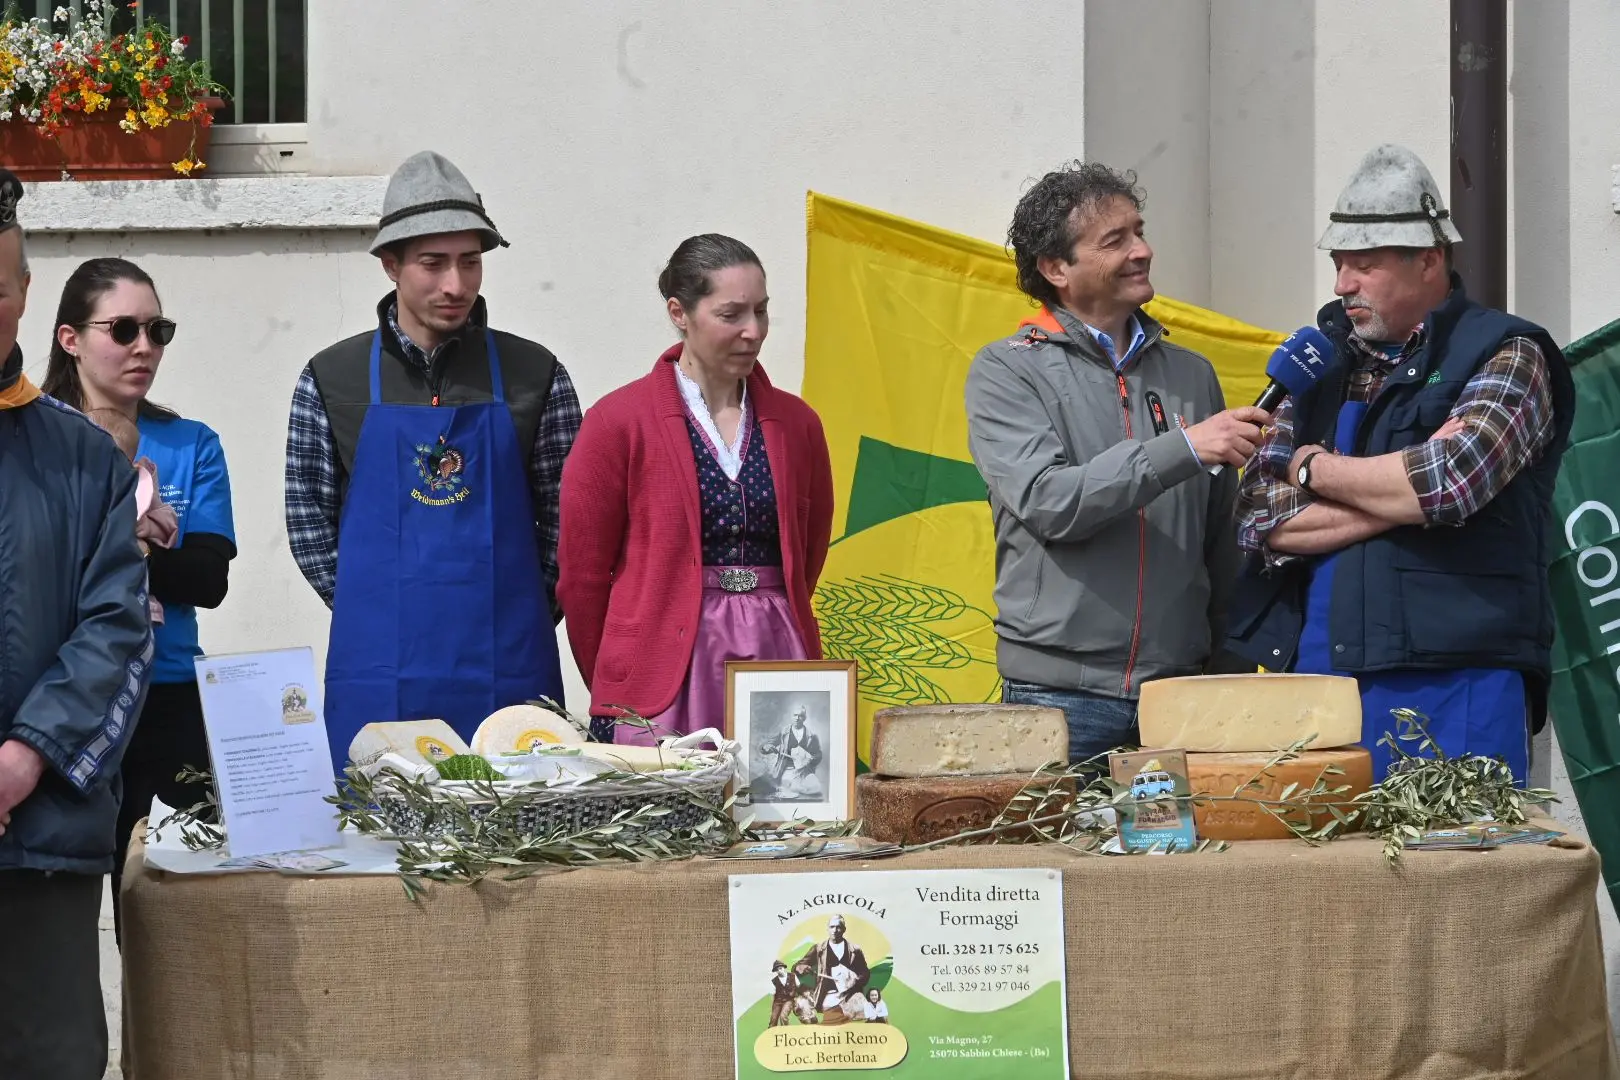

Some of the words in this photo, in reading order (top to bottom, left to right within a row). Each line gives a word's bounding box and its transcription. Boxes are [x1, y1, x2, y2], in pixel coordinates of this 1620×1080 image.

[916, 885, 981, 902] Vendita
[986, 885, 1040, 901] diretta
[803, 893, 888, 919] AGRICOLA
[939, 910, 1019, 930] Formaggi
[920, 944, 950, 955] Cell.
[952, 944, 976, 955] 328
[979, 944, 993, 954] 21
[997, 943, 1013, 954] 75
[1016, 943, 1039, 954] 625
[931, 965, 952, 975] Tel.
[954, 965, 980, 975] 0365
[984, 964, 997, 974] 89
[1000, 964, 1013, 974] 57
[1016, 964, 1030, 974] 84
[931, 981, 955, 992] Cell.
[958, 981, 977, 992] 329
[980, 981, 991, 992] 21
[995, 981, 1008, 992] 97
[1010, 981, 1030, 991] 046
[774, 1031, 841, 1048] Flocchini
[845, 1031, 888, 1045] Remo
[928, 1035, 944, 1044] Via
[946, 1035, 980, 1046] Magno,
[981, 1035, 993, 1043] 27
[785, 1053, 813, 1065] Loc.
[816, 1051, 878, 1064] Bertolana
[929, 1049, 958, 1058] 25070
[959, 1048, 990, 1058] Sabbio
[992, 1047, 1023, 1057] Chiese
[1029, 1046, 1050, 1058] (Bs)
